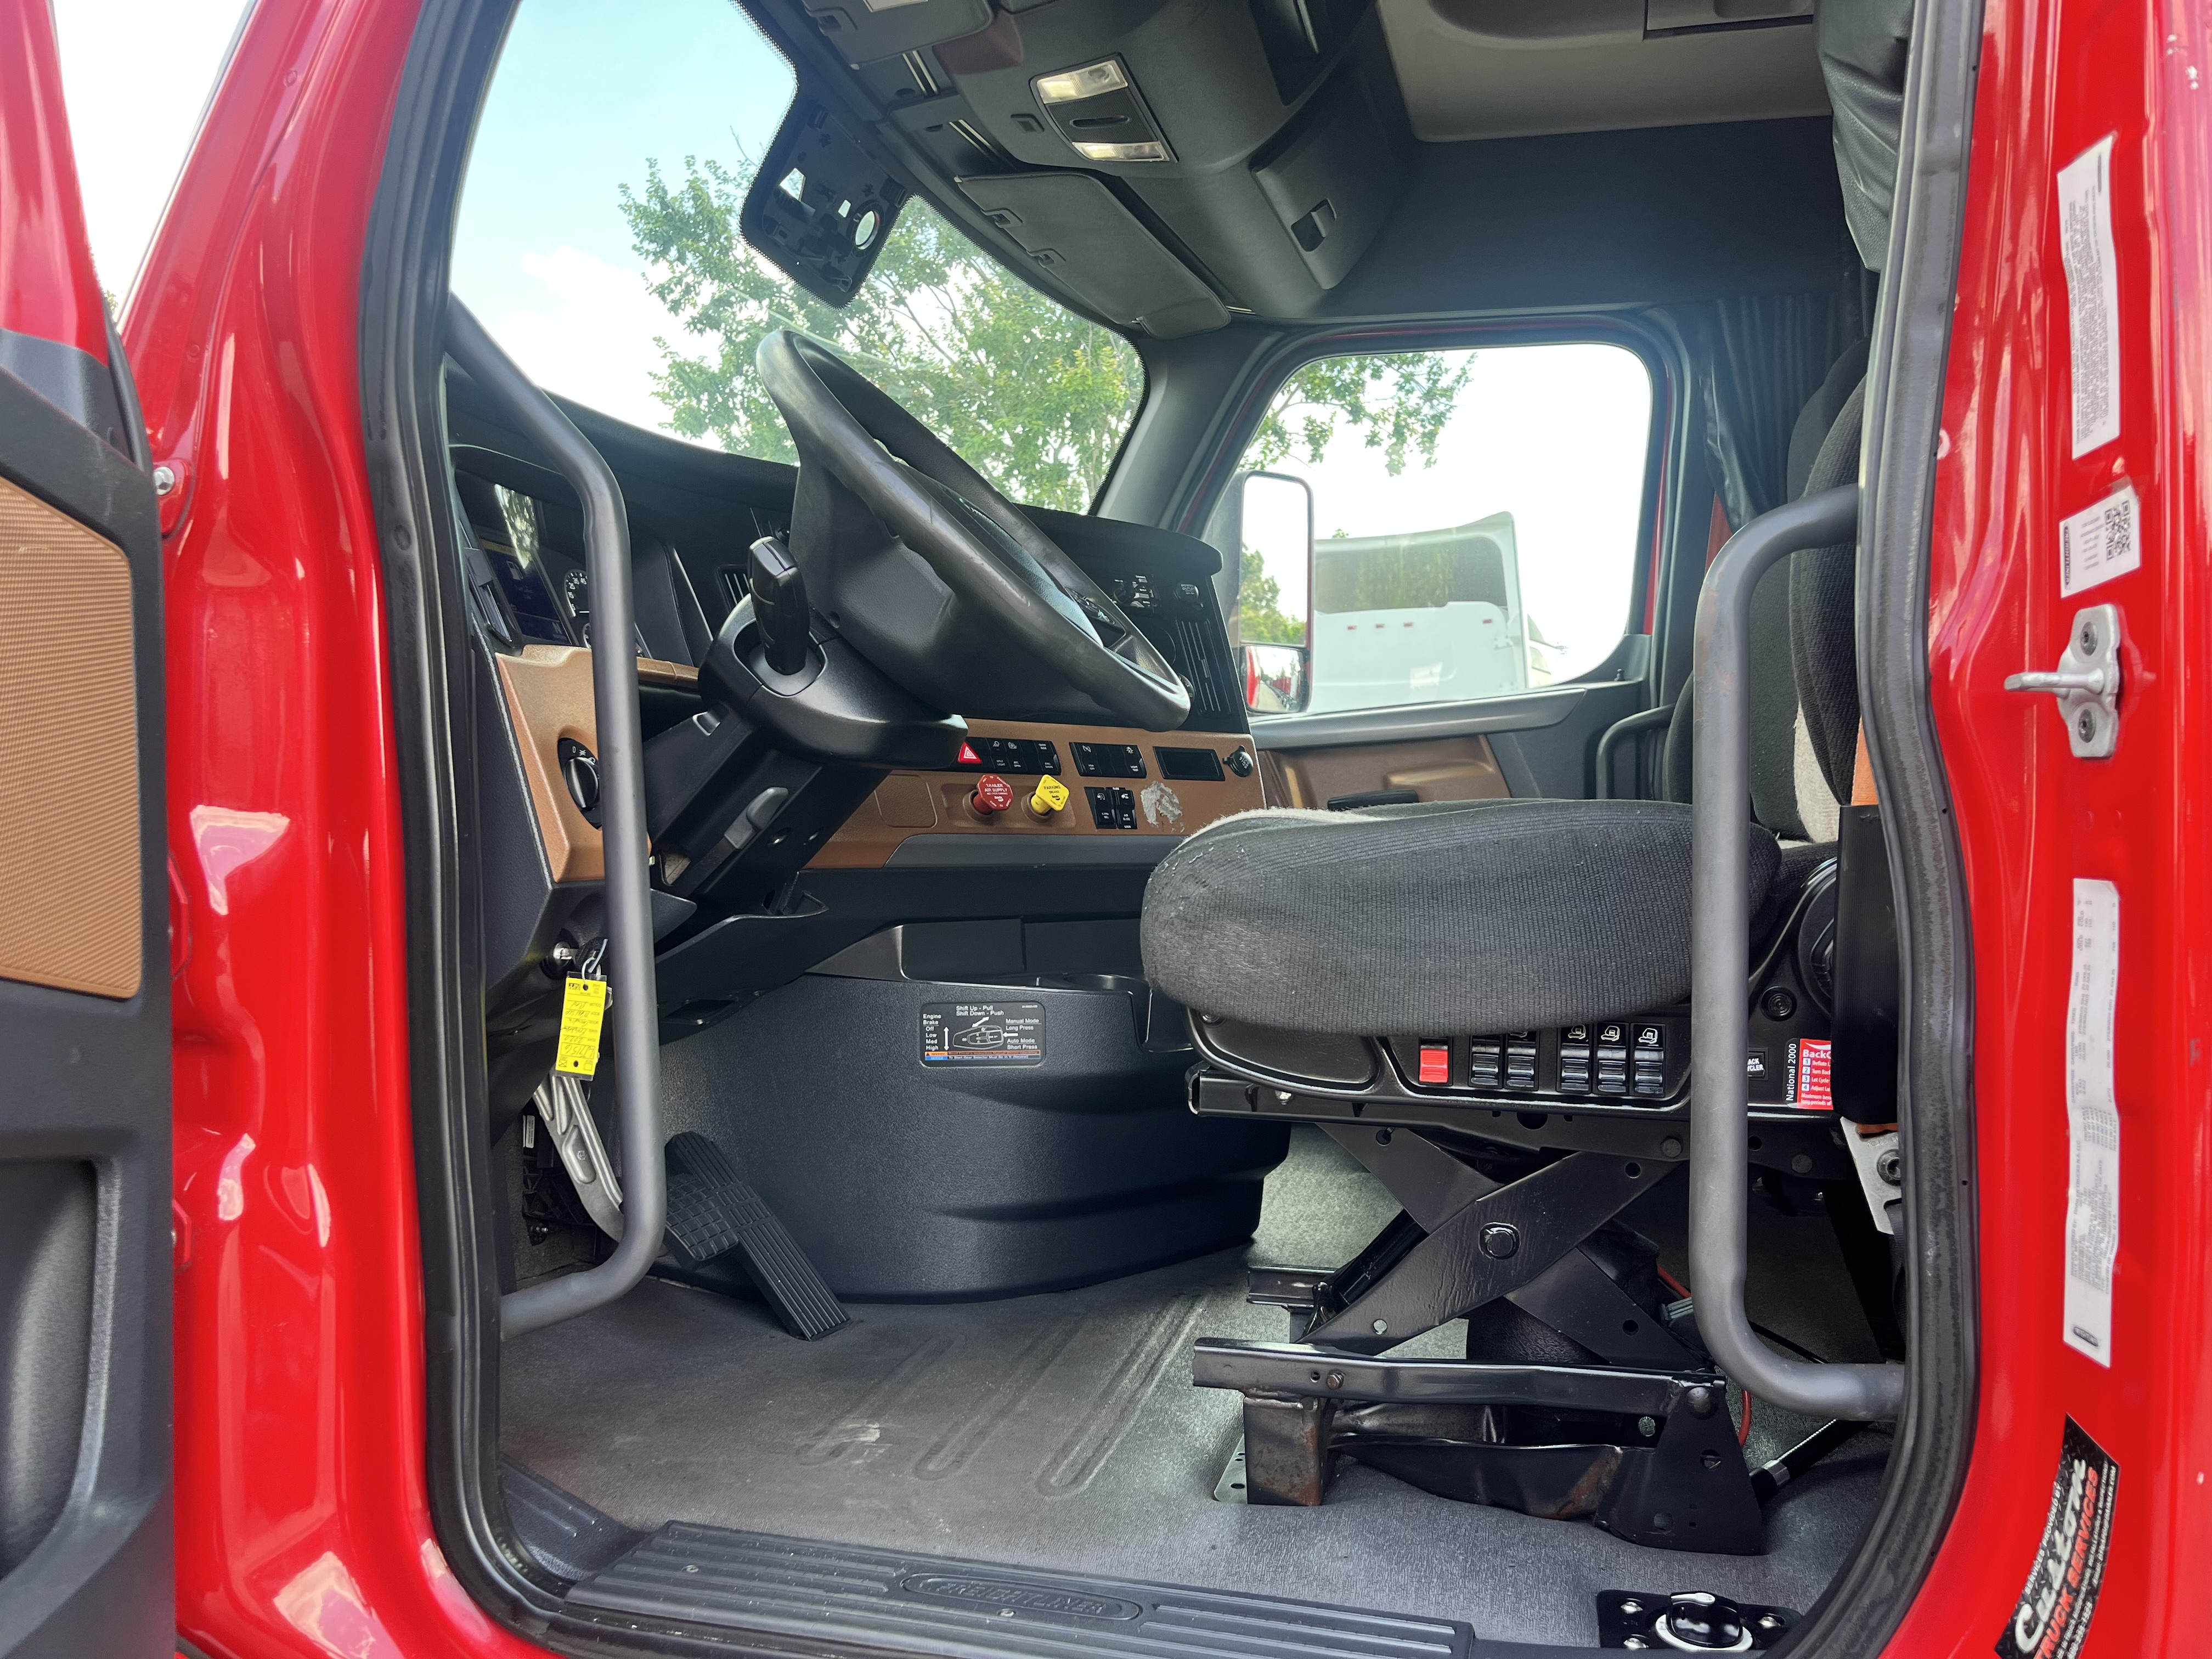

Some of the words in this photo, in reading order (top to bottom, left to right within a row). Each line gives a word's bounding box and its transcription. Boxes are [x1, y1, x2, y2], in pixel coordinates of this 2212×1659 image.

[1786, 1066, 1796, 1101] National
[1788, 1043, 1797, 1064] 2000
[2015, 1458, 2086, 1654] Custom
[2024, 1549, 2045, 1596] SERVICES
[2042, 1497, 2060, 1548] PROVIDED
[2032, 1586, 2074, 1659] TRUCK
[2067, 1466, 2100, 1589] SERVICES
[2064, 1618, 2076, 1641] TRUCK
[2088, 1515, 2101, 1567] INSTALLATIONS
